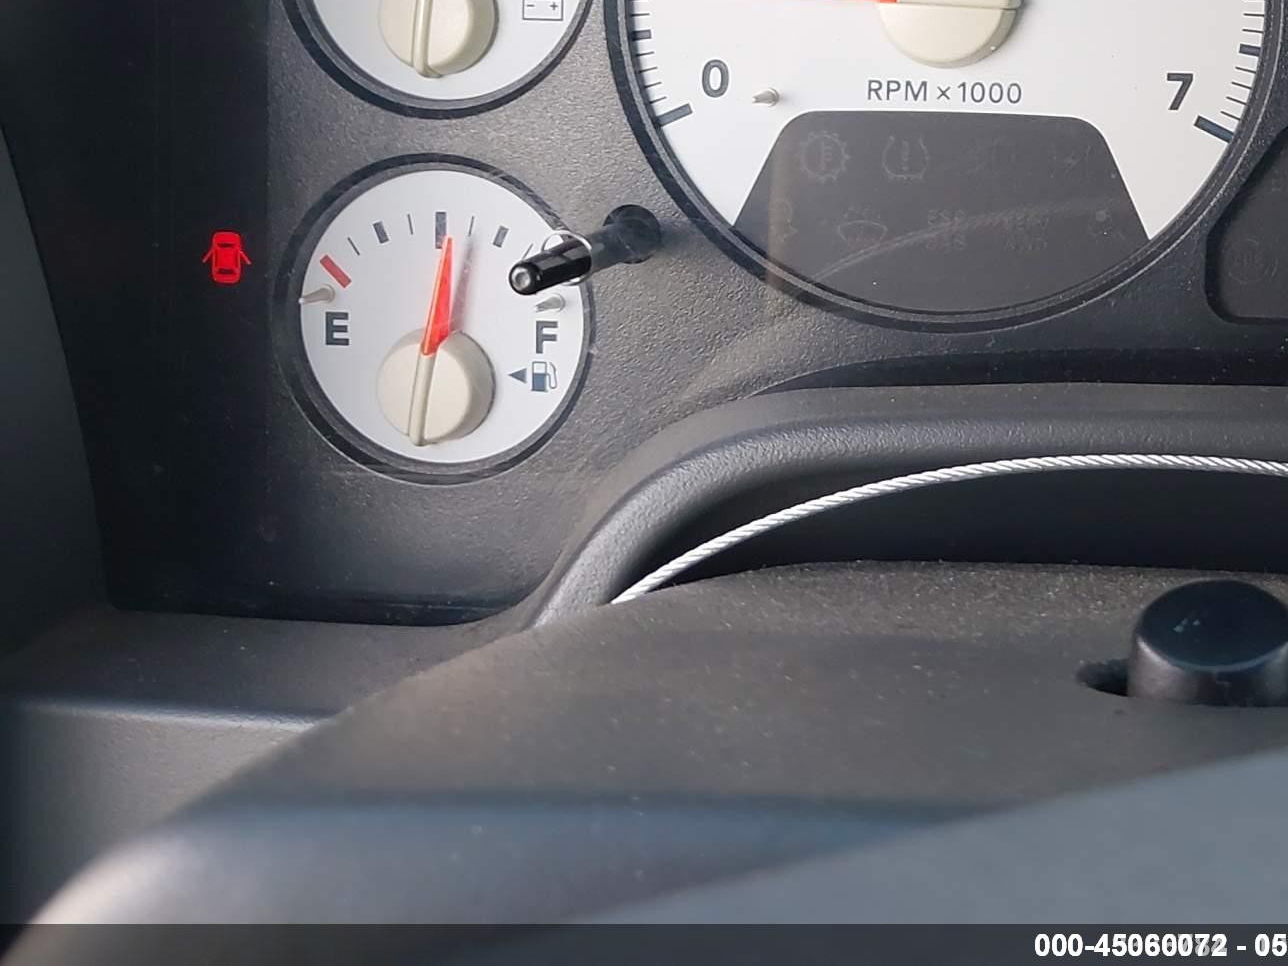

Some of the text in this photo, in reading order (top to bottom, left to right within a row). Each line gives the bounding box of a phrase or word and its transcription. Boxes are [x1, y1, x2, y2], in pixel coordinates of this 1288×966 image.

[701, 59, 730, 99] 0
[867, 79, 928, 102] RPM
[1166, 72, 1194, 111] 7
[324, 311, 350, 347] E
[535, 320, 559, 355] F
